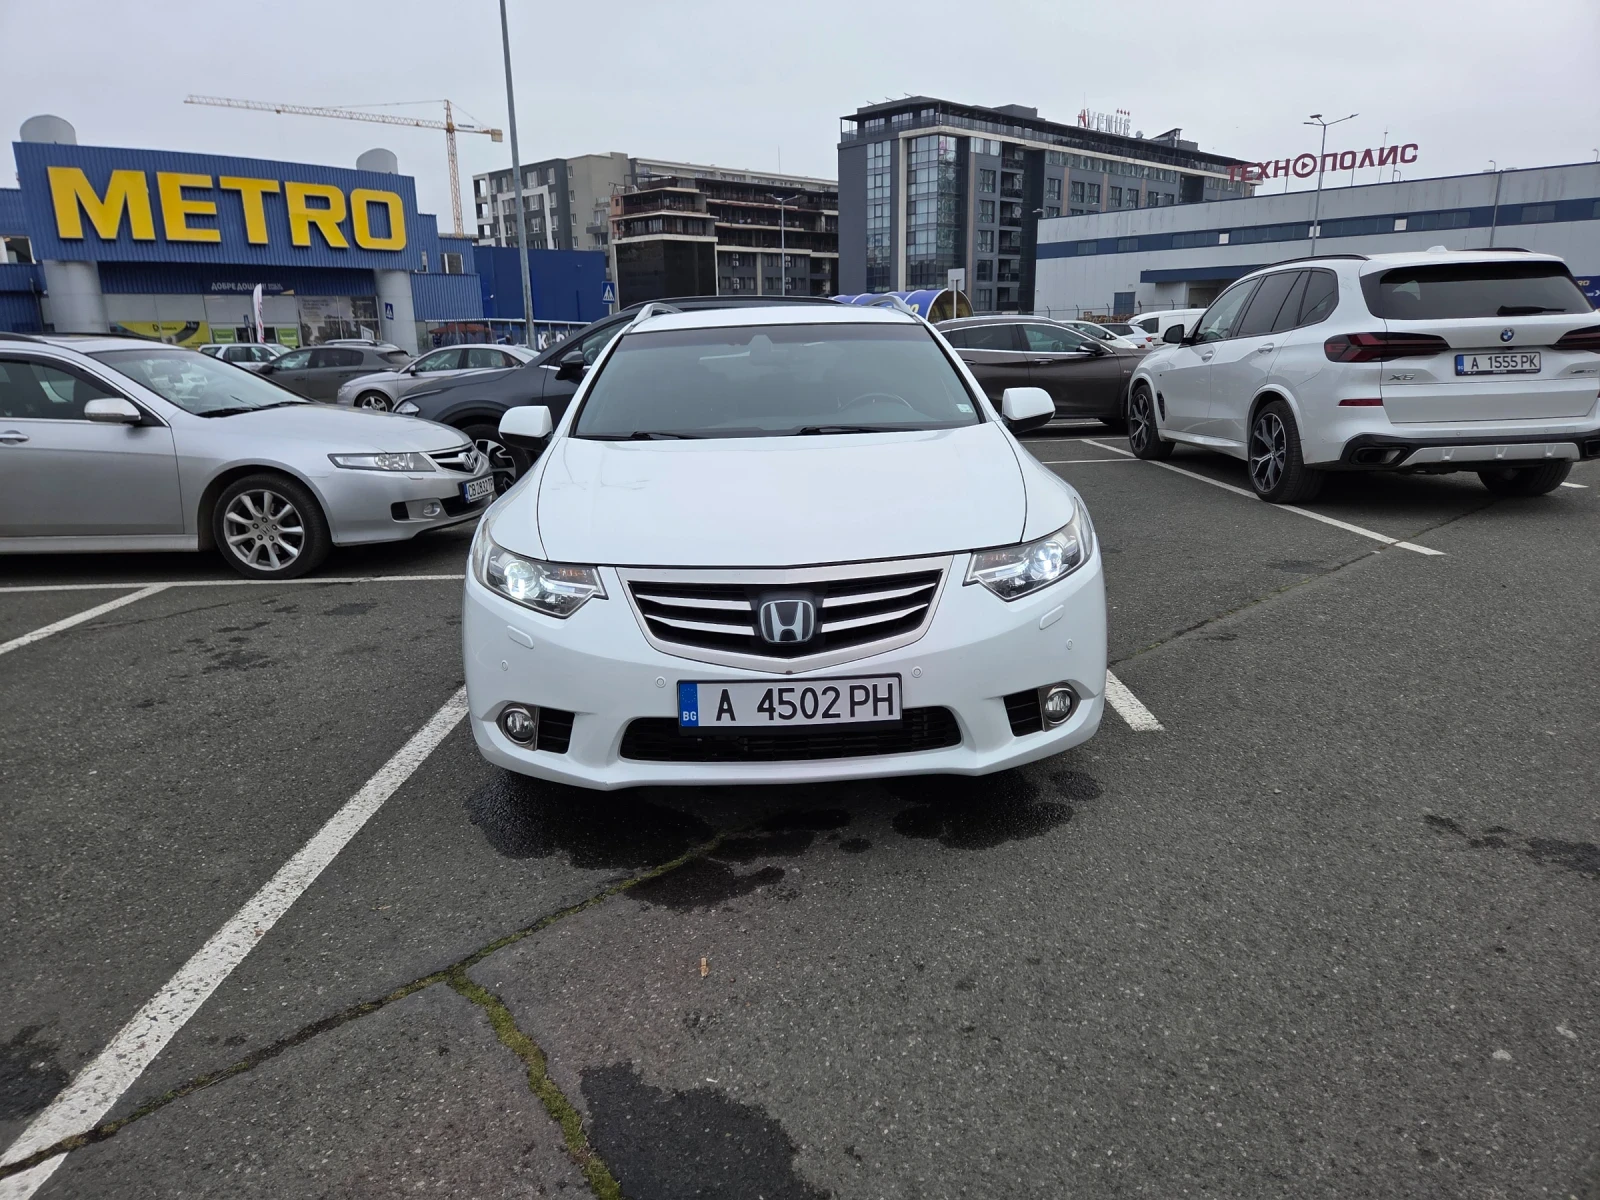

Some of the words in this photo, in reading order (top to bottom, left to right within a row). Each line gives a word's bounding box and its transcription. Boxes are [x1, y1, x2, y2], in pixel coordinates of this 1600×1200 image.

[1077, 109, 1131, 137] AVENUE
[1226, 143, 1419, 183] ТЕХНОПОЛИС
[47, 165, 407, 251] METRO
[211, 282, 236, 292] ДОБРЕ
[1471, 356, 1480, 370] A
[1488, 354, 1518, 369] 1555
[1521, 353, 1538, 368] PK
[682, 710, 697, 722] BG
[715, 688, 737, 722] A
[756, 685, 841, 721] 4502
[849, 682, 894, 718] PH
